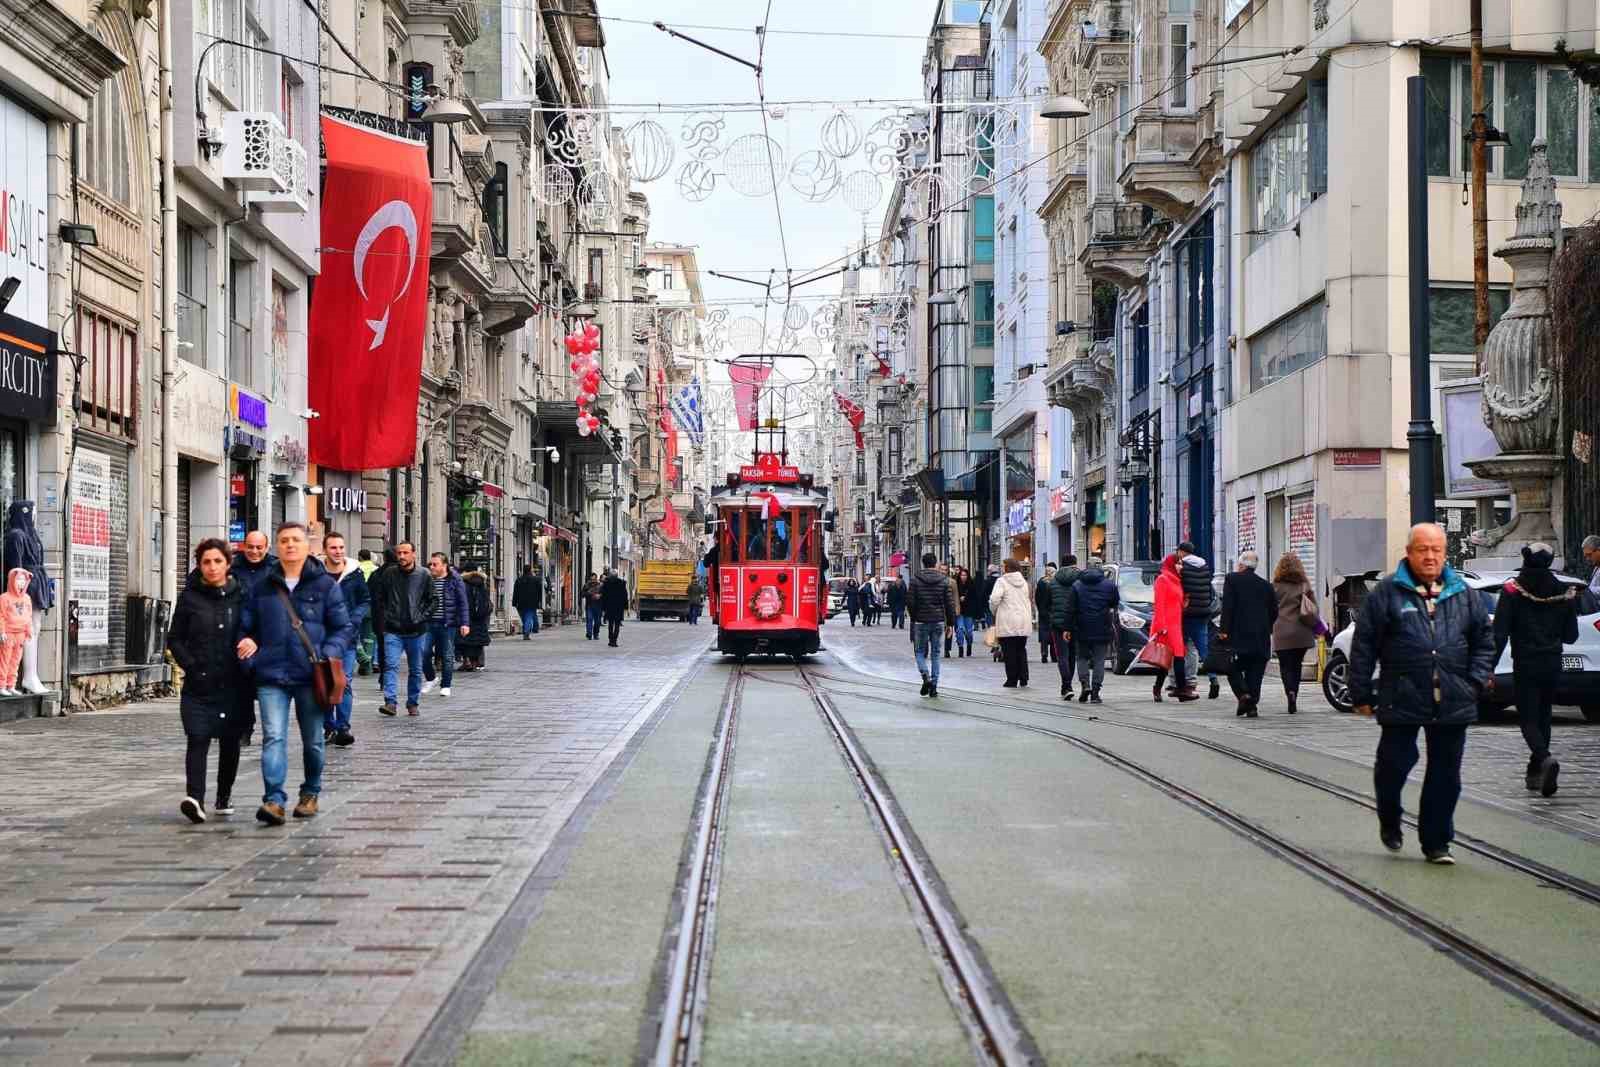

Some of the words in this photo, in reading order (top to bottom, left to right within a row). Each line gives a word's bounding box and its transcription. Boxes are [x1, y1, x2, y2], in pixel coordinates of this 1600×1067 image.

[9, 194, 45, 272] SALE
[0, 346, 45, 399] RCITY
[766, 455, 773, 465] 2
